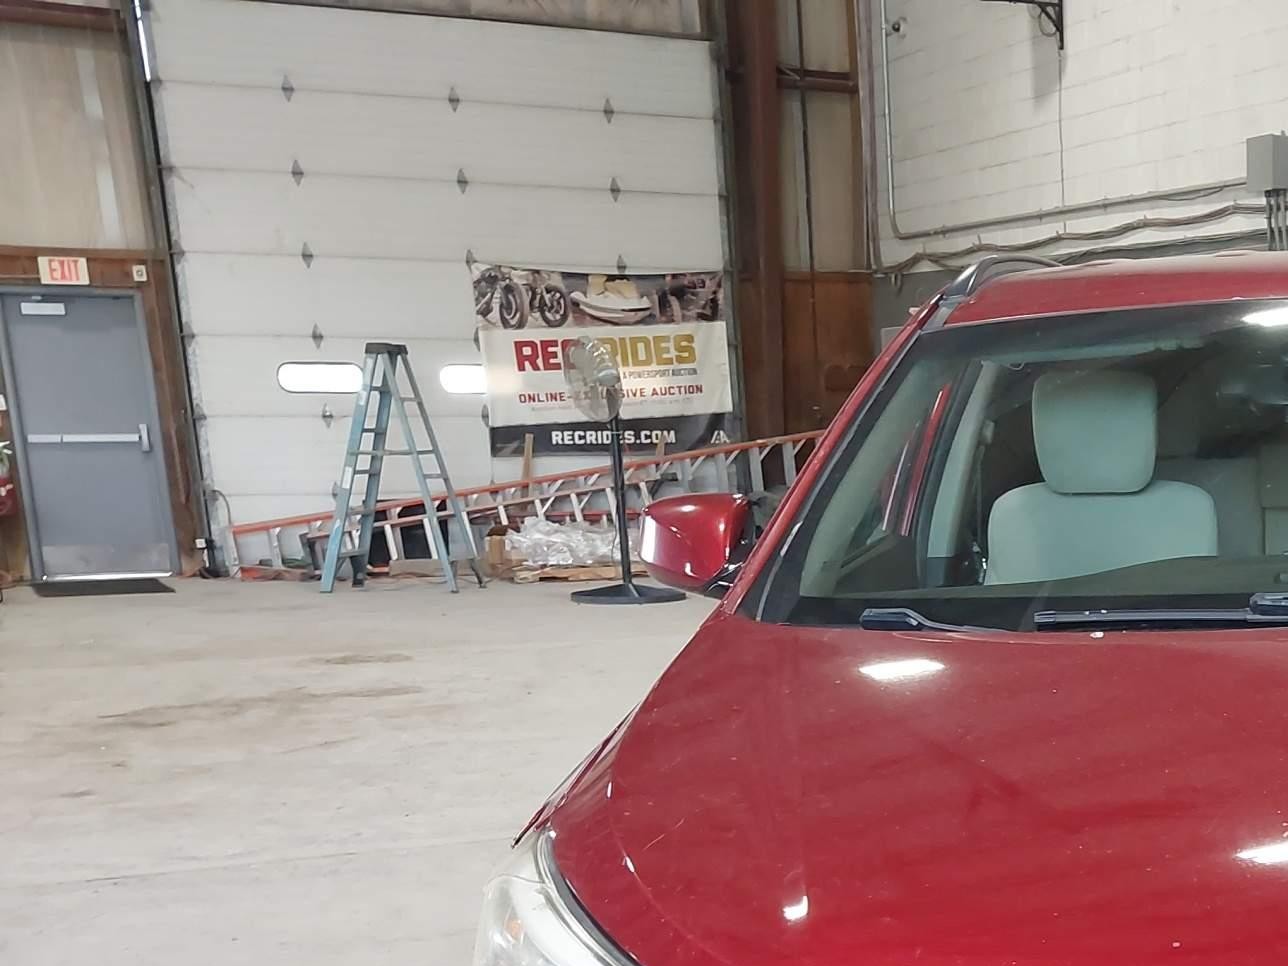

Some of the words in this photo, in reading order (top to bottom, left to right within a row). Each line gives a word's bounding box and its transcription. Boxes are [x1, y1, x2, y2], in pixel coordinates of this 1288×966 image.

[48, 258, 81, 282] EXIT
[651, 384, 703, 398] AUCTION
[551, 429, 676, 445] RECRIDS.COM
